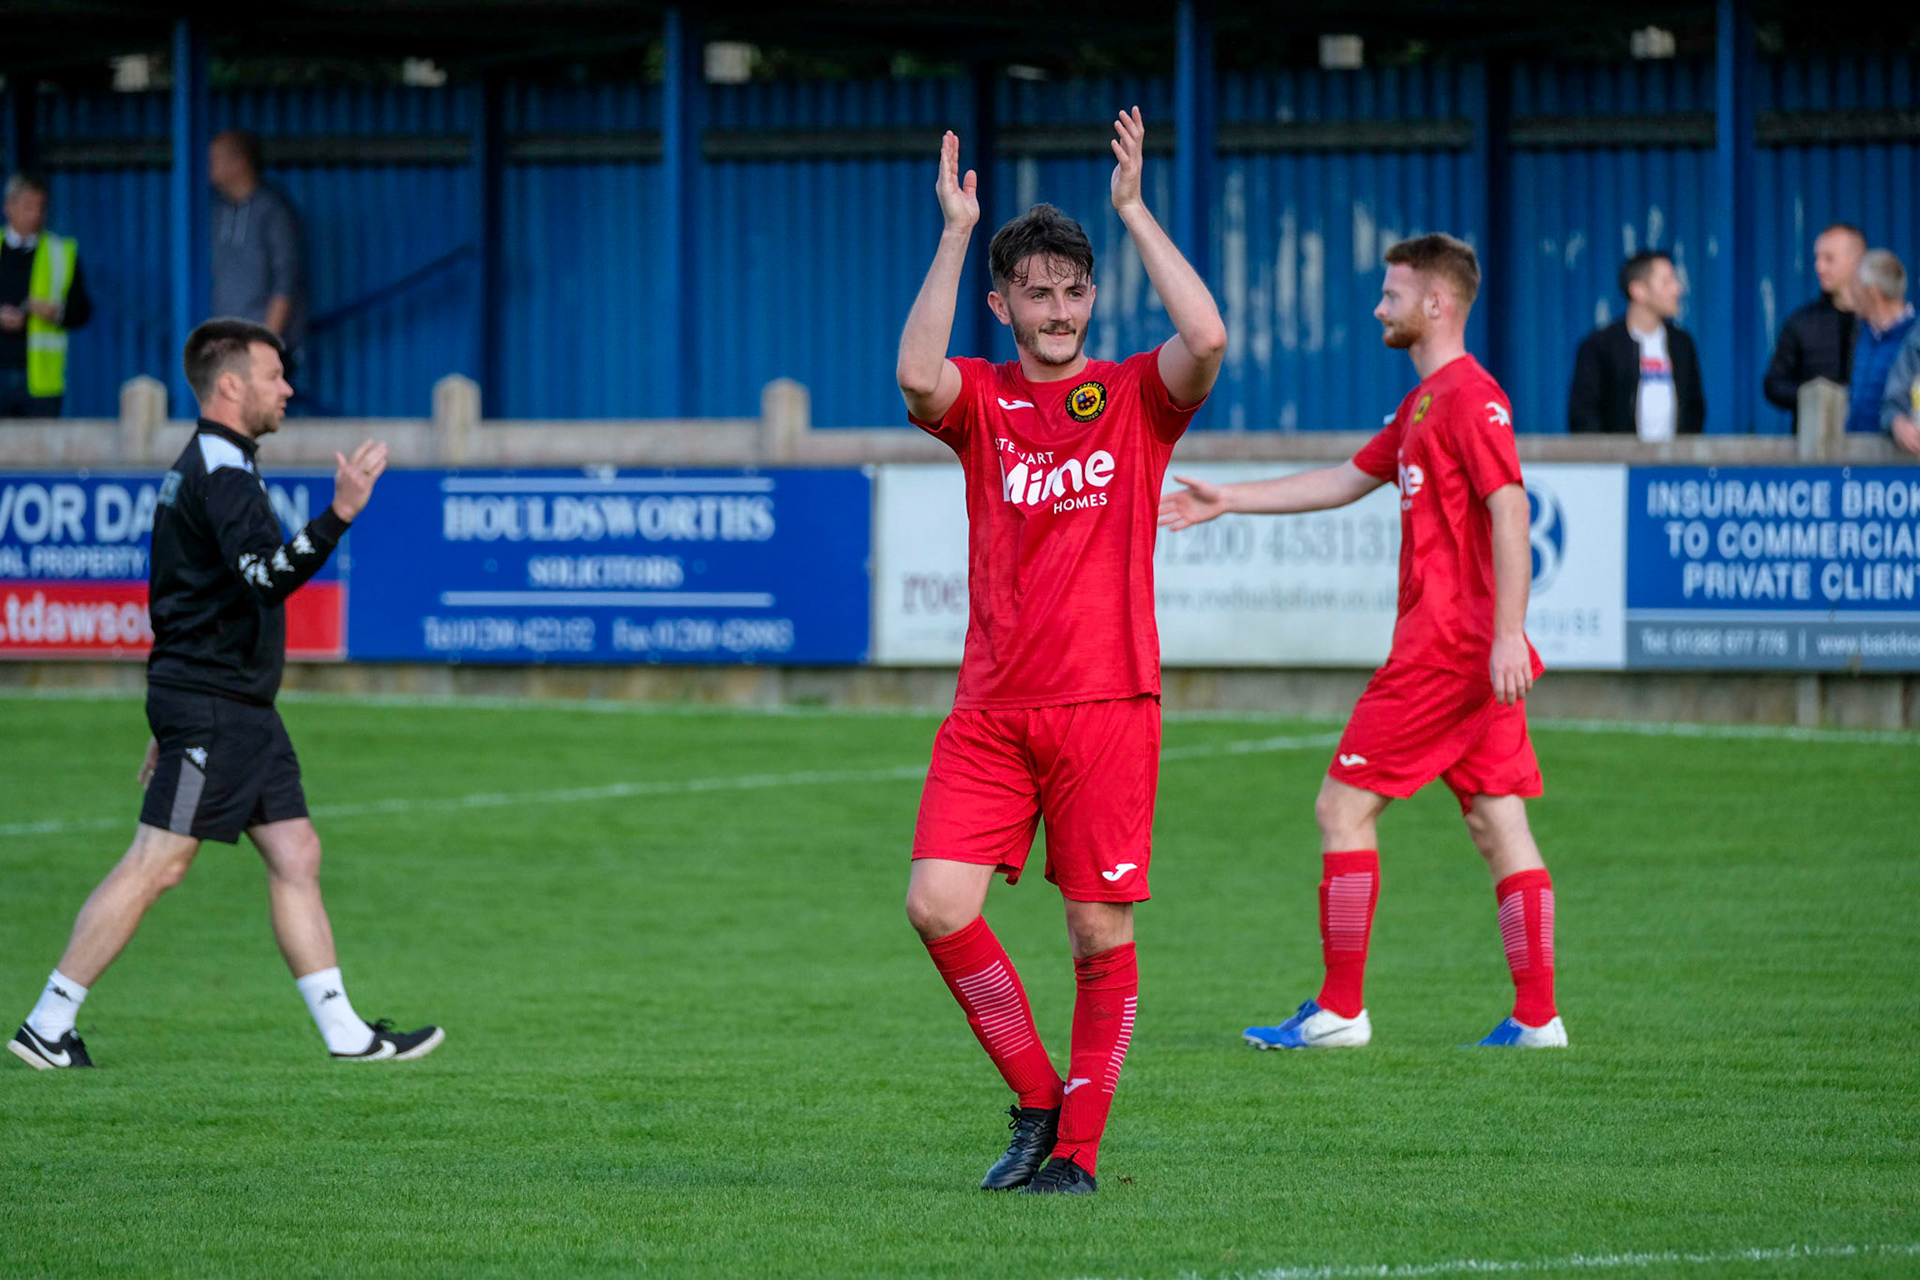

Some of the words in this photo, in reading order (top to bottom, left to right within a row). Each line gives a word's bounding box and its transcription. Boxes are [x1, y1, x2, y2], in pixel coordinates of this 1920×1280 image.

[1053, 492, 1108, 515] HOMES
[1647, 480, 1831, 518] INSURANCE
[443, 496, 776, 542] HOULDSWORTHS
[1664, 521, 1710, 559] TO
[30, 545, 149, 578] PROPERTY
[528, 555, 684, 588] SOLICITORS
[1683, 562, 1811, 600] PRIVATE
[1821, 562, 1920, 601] CLIEN
